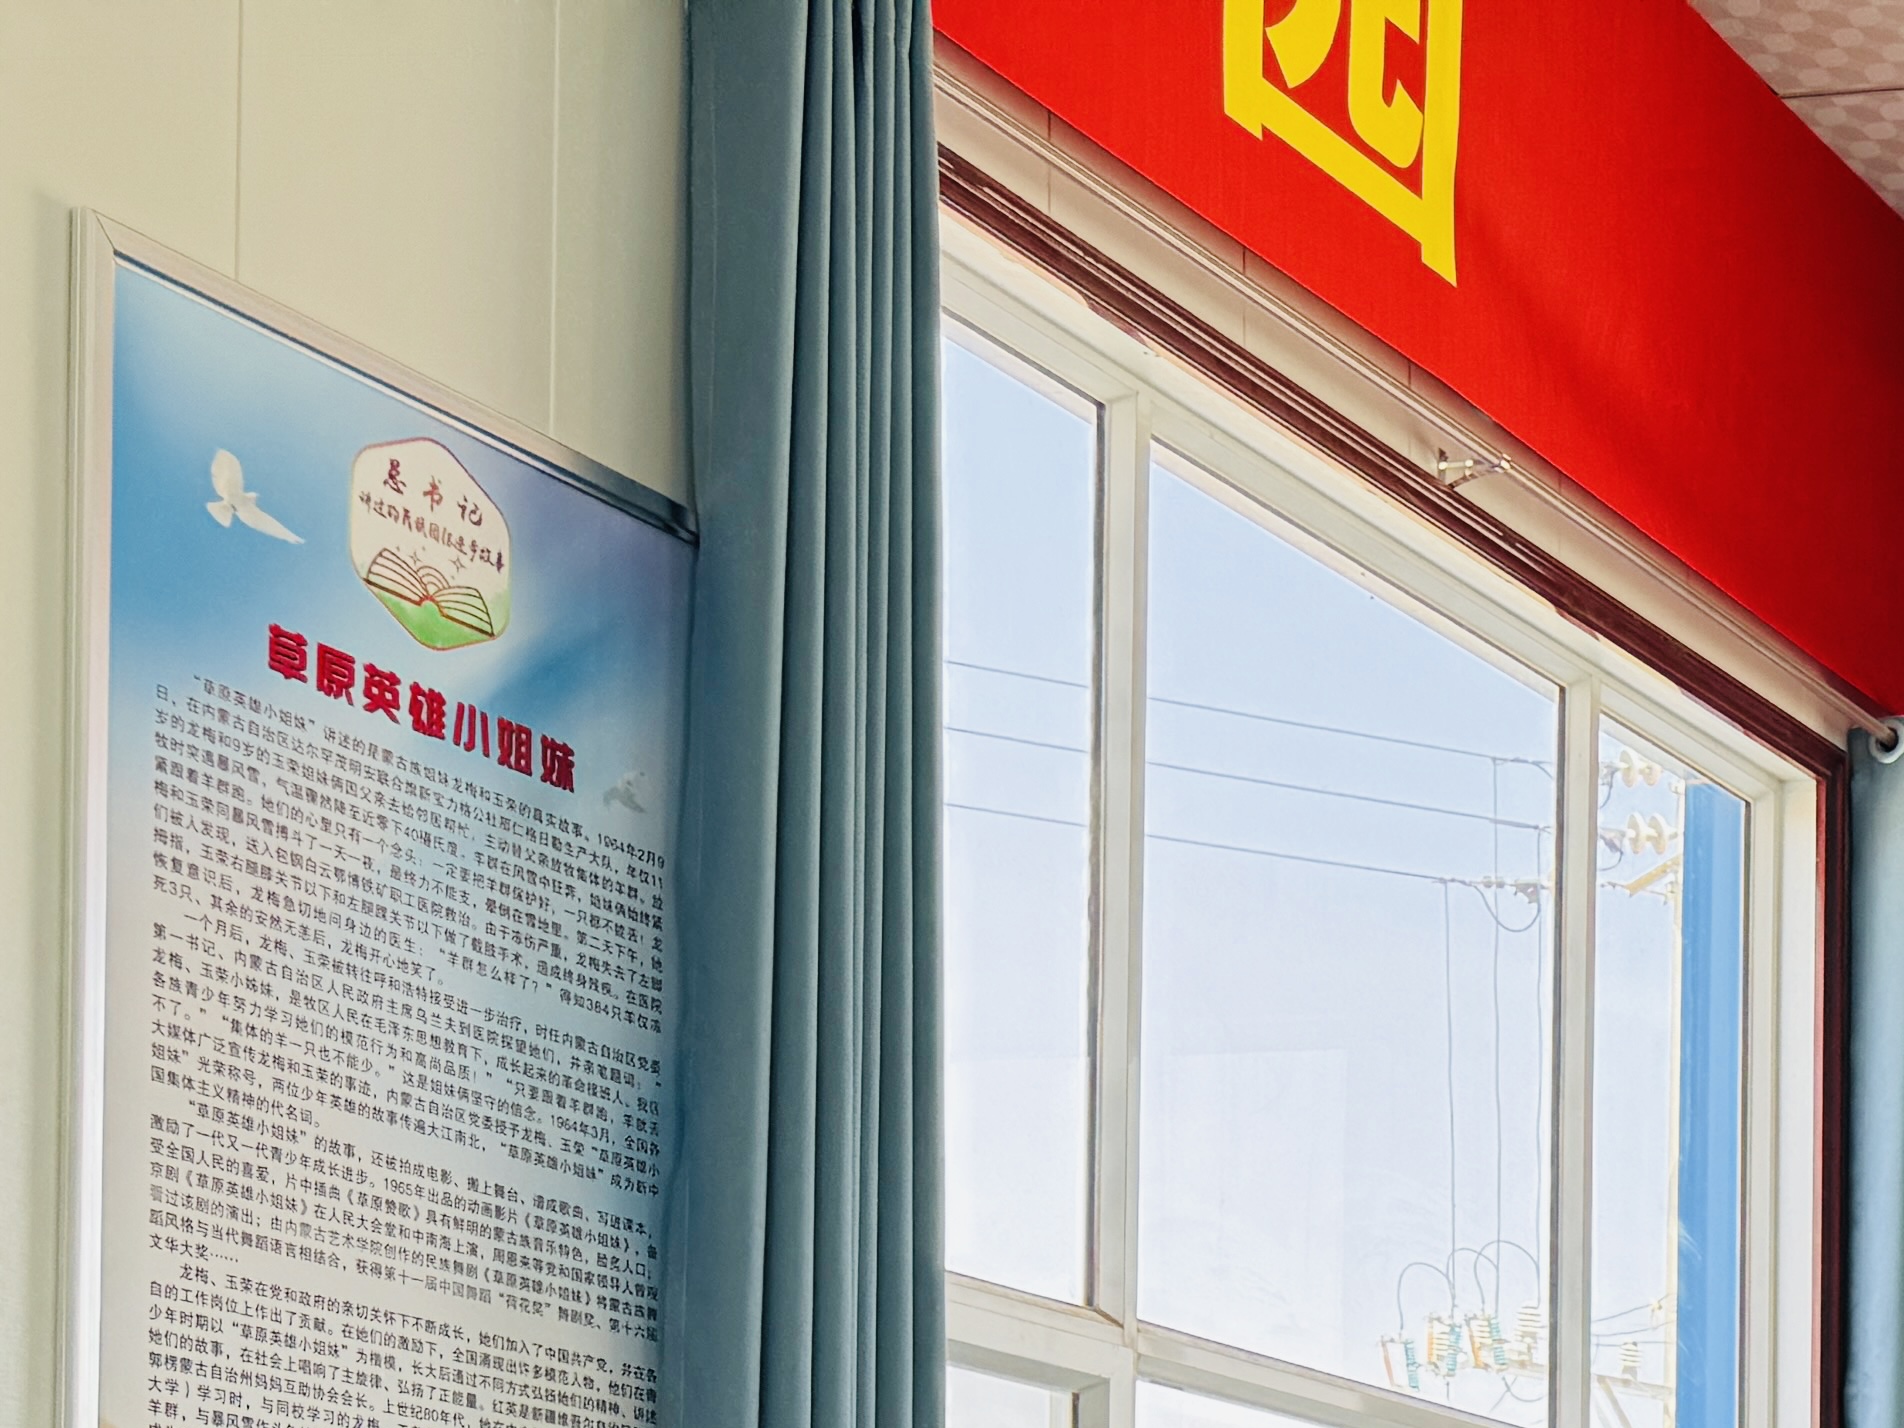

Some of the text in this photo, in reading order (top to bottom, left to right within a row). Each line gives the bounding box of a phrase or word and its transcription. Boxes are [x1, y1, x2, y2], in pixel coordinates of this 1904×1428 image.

[267, 623, 576, 793] 草原英雄小姐妹
